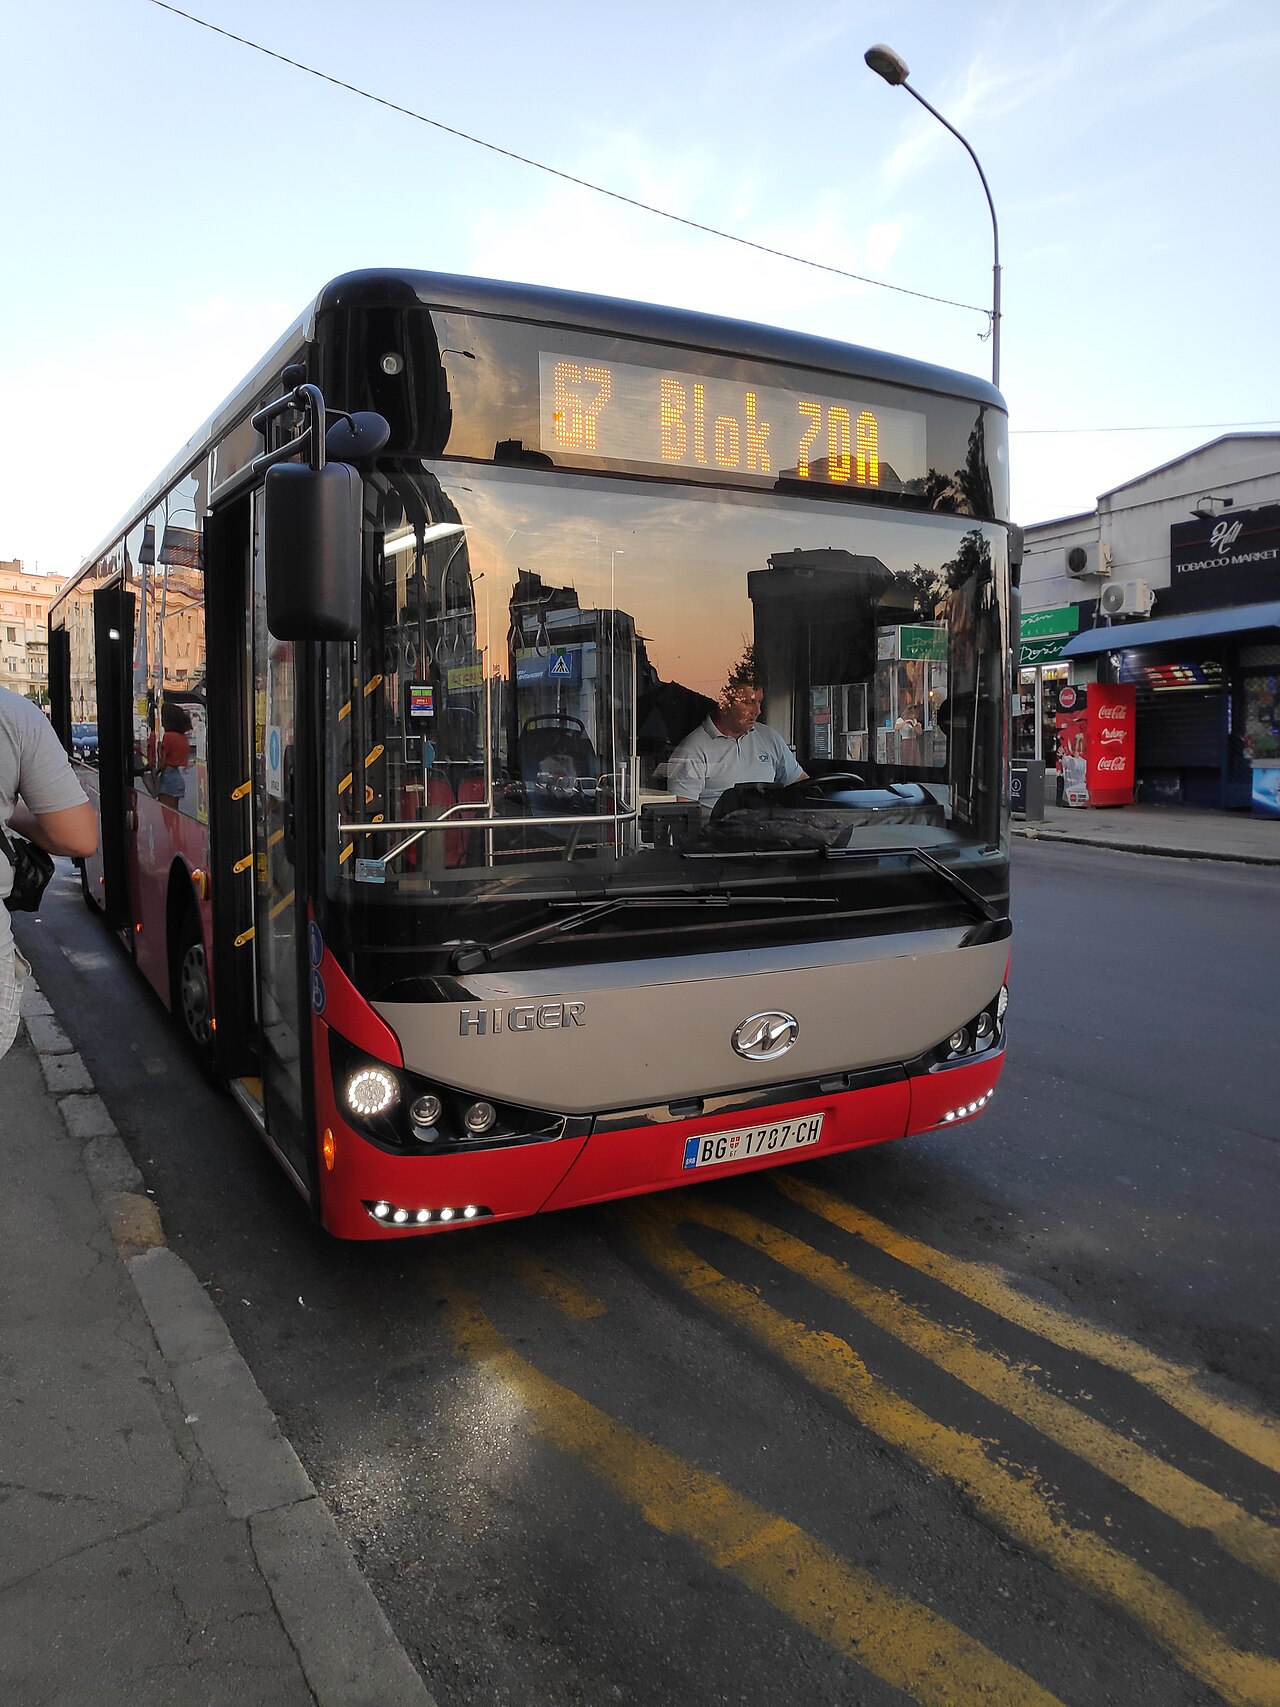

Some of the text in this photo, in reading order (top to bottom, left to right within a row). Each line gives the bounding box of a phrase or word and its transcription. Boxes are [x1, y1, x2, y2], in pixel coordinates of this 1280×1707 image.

[553, 361, 879, 487] 67 Blok 70A
[1176, 549, 1279, 573] TOBACCO MARKET
[1098, 704, 1127, 720] Coca-Cola
[1097, 756, 1126, 771] Coca-Cola
[459, 1001, 586, 1036] HIGER
[701, 1137, 728, 1162] BG
